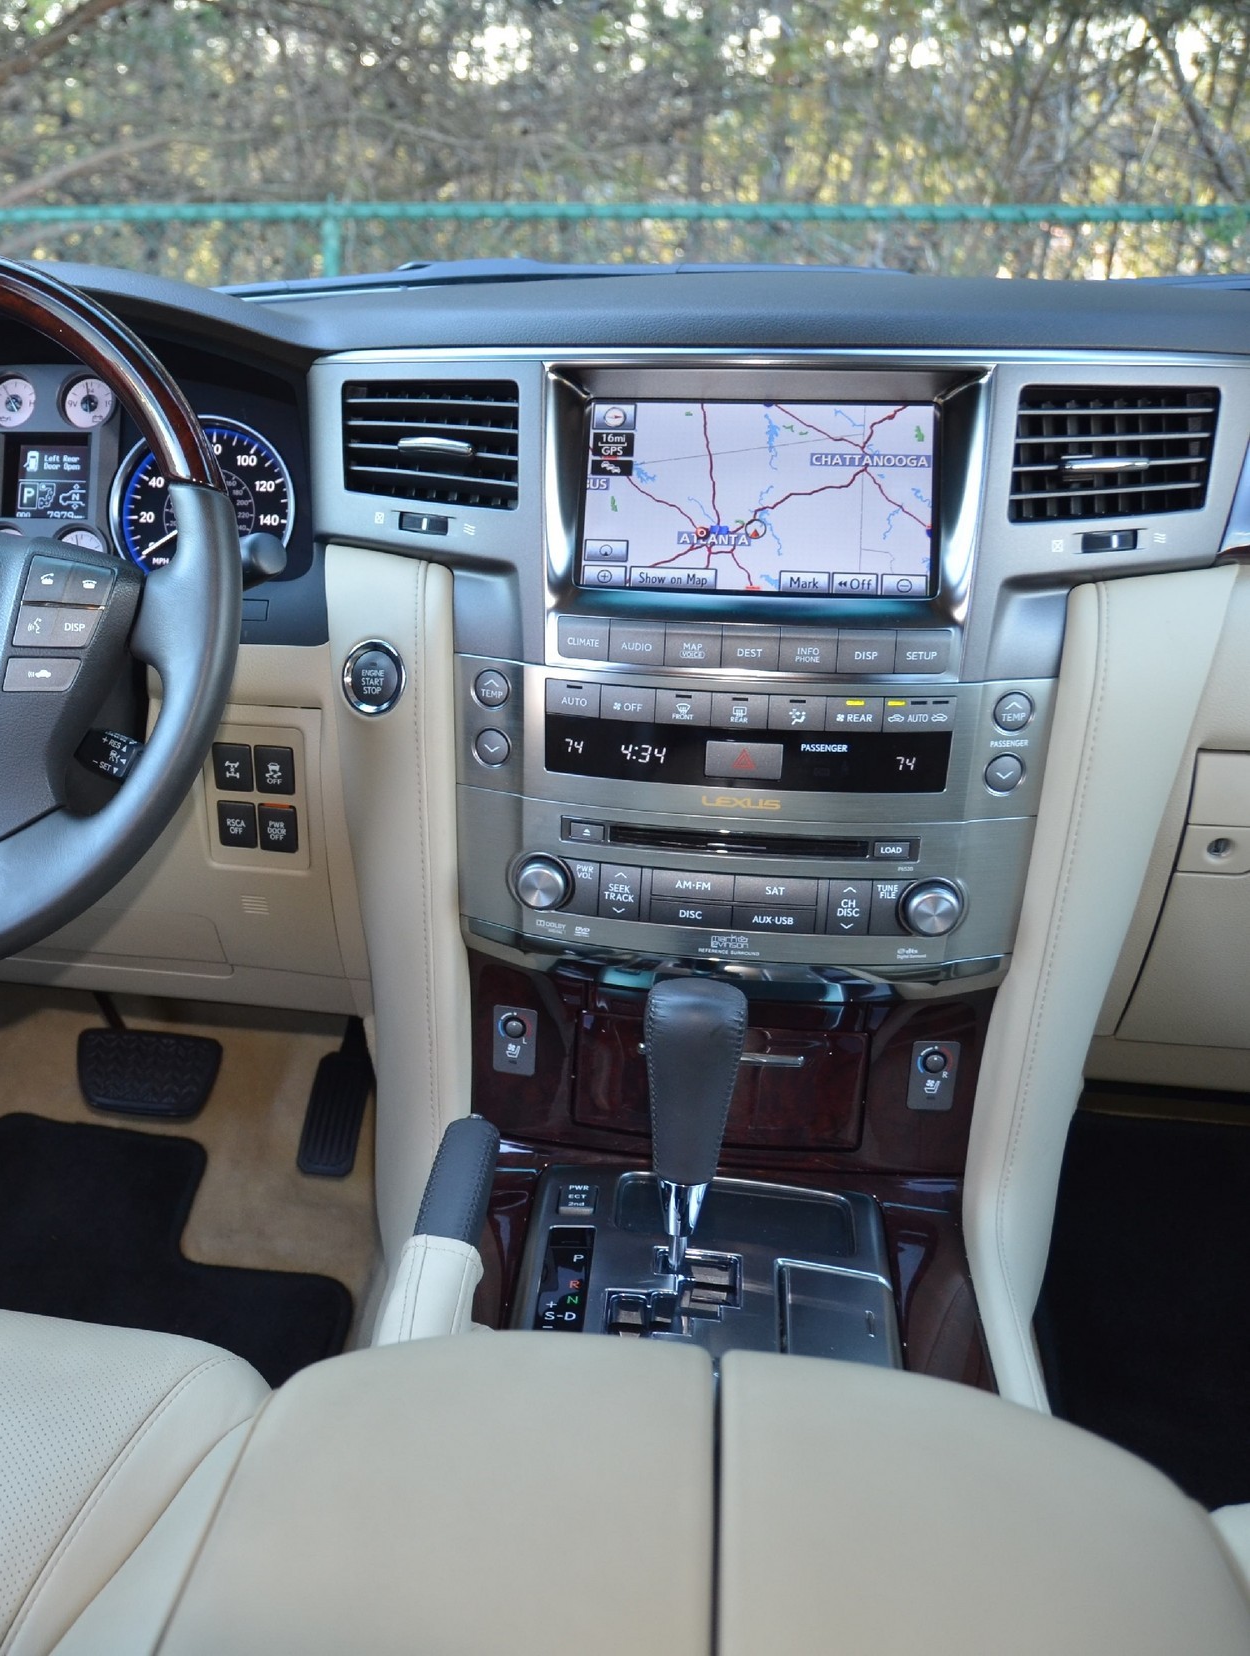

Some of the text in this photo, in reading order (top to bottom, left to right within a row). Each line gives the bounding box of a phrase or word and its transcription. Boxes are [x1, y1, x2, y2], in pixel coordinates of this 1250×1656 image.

[602, 434, 626, 442] 16mi
[601, 446, 623, 456] GPS
[44, 454, 80, 462] Left Rear
[236, 454, 257, 466] 100
[812, 454, 929, 468] CHATTANOOGA
[44, 462, 81, 471] Door Open
[148, 476, 165, 488] 40
[254, 480, 276, 492] 120
[23, 488, 35, 504] P
[138, 511, 156, 523] 20
[258, 514, 280, 526] 140
[638, 572, 708, 588] Show on Map
[789, 576, 819, 590] Mark
[850, 577, 872, 590] Off
[64, 622, 86, 633] DISP
[567, 637, 600, 648] CLIMATE
[621, 642, 653, 652] AUDIO
[682, 642, 703, 651] MAP
[736, 648, 763, 658] DEST
[796, 648, 820, 656] INFO
[854, 652, 878, 660] DISP
[906, 651, 938, 661] SETUP
[794, 656, 821, 664] PHONE
[361, 678, 385, 686] START
[363, 686, 382, 695] STOP
[480, 688, 504, 698] TEMP
[561, 696, 588, 707] AUTO
[623, 702, 643, 713] OFF
[672, 712, 694, 721] FRONT
[730, 716, 748, 724] REAR
[846, 713, 874, 722] REAR
[907, 714, 929, 722] AUTO
[1001, 710, 1026, 722] TEMP
[108, 738, 122, 750] RES
[564, 738, 584, 754] 74
[800, 743, 848, 753] PASSENGER
[989, 739, 1030, 748] PASSENGER
[620, 744, 667, 764] 4:34
[98, 761, 112, 772] SET
[896, 756, 917, 772] 74
[701, 795, 782, 811] LEXUS
[226, 818, 246, 828] RSCA
[268, 820, 285, 829] PWR
[230, 826, 243, 835] OFF
[267, 826, 286, 836] DOOR
[576, 864, 594, 873] PWR
[577, 872, 592, 880] VOL
[608, 883, 630, 894] SEEK
[766, 886, 786, 896] SAT
[876, 884, 899, 892] TUNE
[604, 891, 634, 903] TRACK
[840, 899, 856, 908] CH
[678, 910, 703, 920] DISC
[836, 908, 860, 917] DISC
[572, 1254, 584, 1263] P
[569, 1280, 580, 1289] R
[566, 1295, 578, 1305] N
